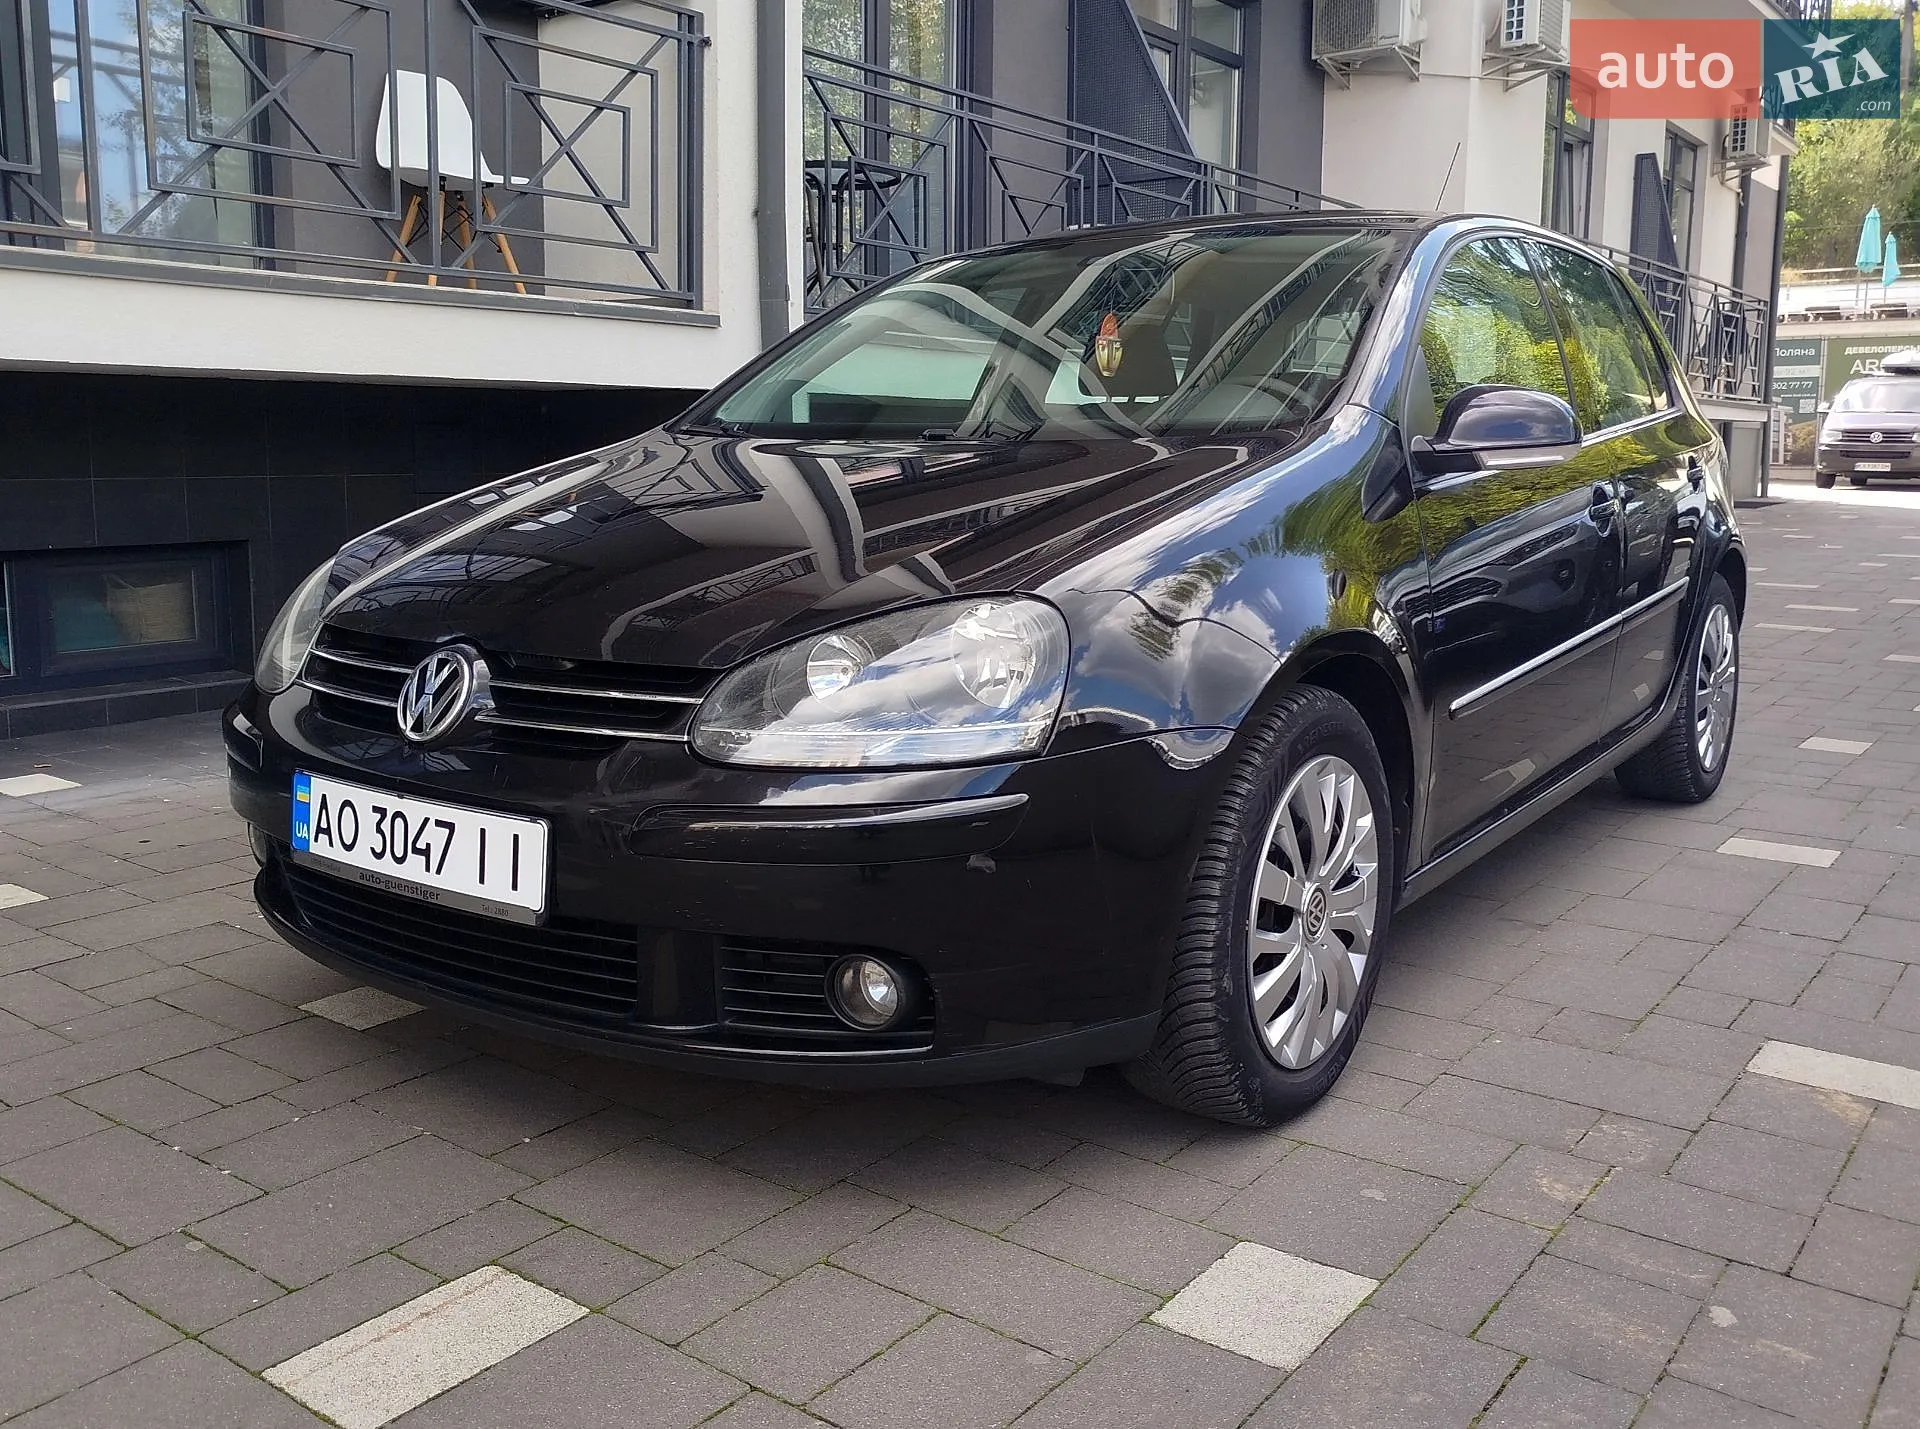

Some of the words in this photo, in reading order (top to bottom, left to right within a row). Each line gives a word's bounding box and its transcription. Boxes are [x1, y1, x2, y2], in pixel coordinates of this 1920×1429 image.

[296, 821, 309, 840] UA
[314, 793, 360, 852] AO
[370, 805, 456, 876] 3047
[359, 870, 441, 901] auto-guenstiger
